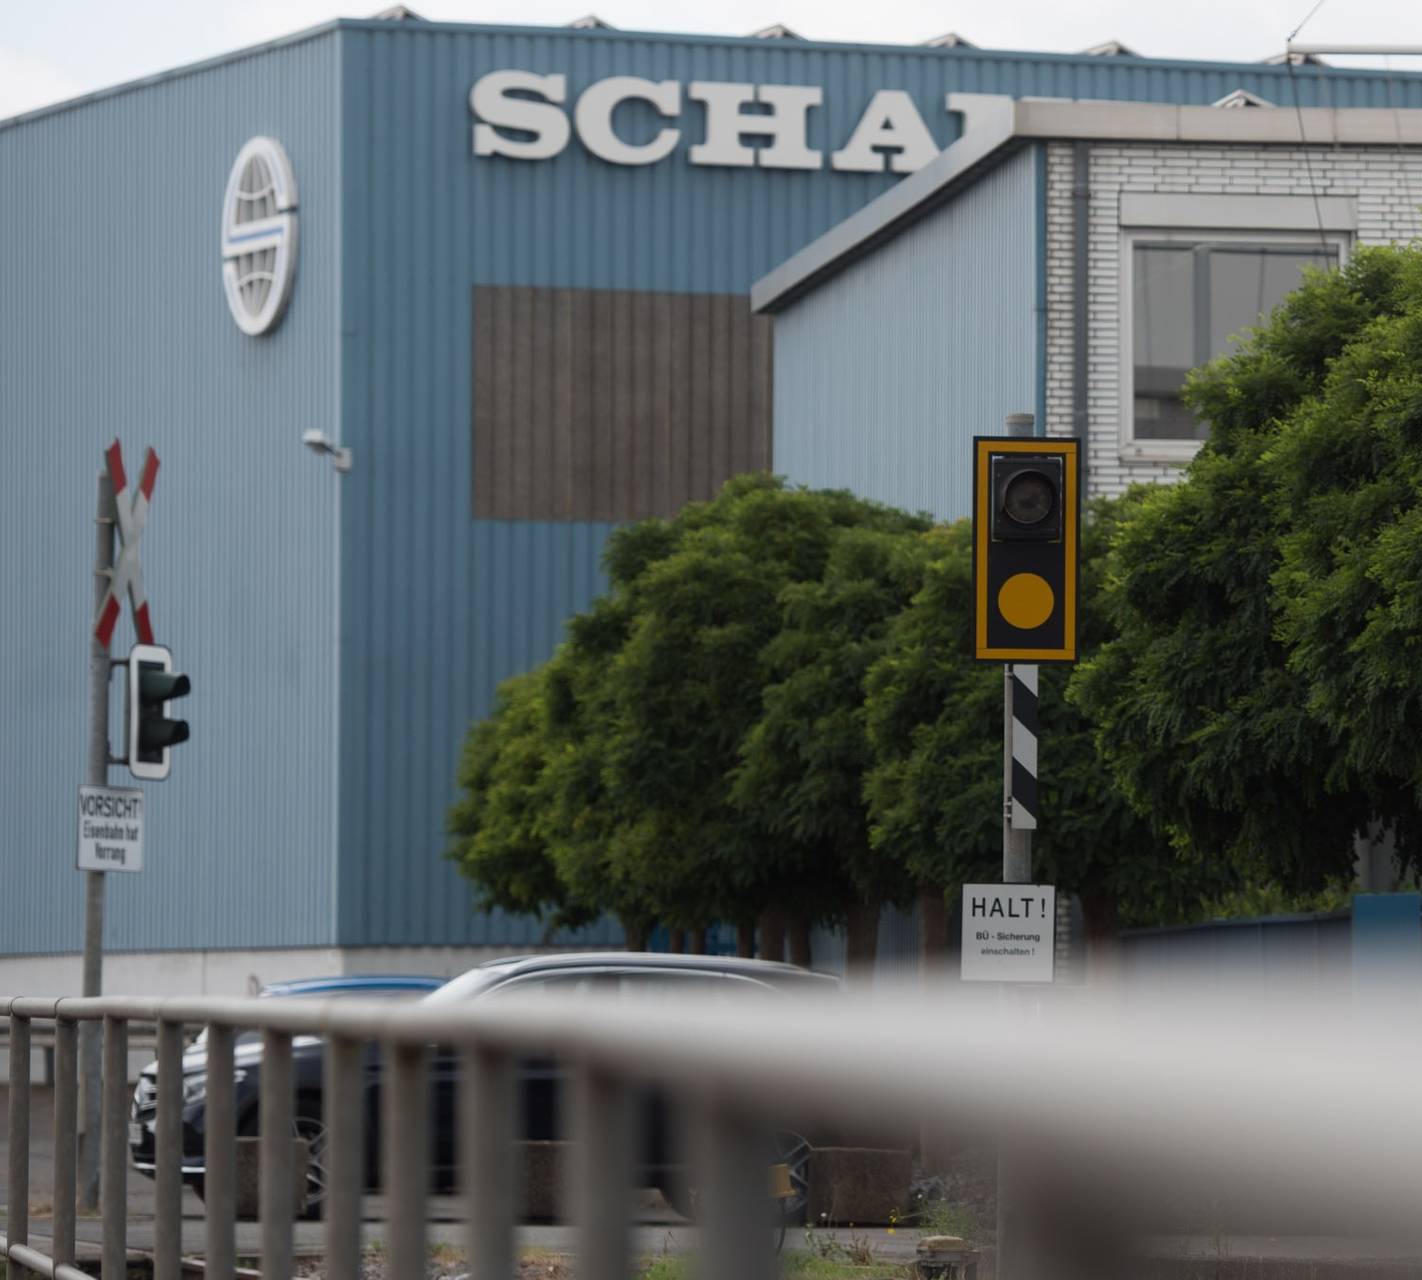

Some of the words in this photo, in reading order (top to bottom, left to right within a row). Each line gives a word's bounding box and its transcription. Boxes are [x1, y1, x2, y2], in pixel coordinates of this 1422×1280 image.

[469, 69, 1012, 174] SCHA
[83, 820, 124, 840] Eisenbahn
[126, 823, 139, 841] hat
[95, 842, 126, 865] Vorrang
[976, 930, 989, 941] BÜ
[996, 931, 1041, 943] Sicherung
